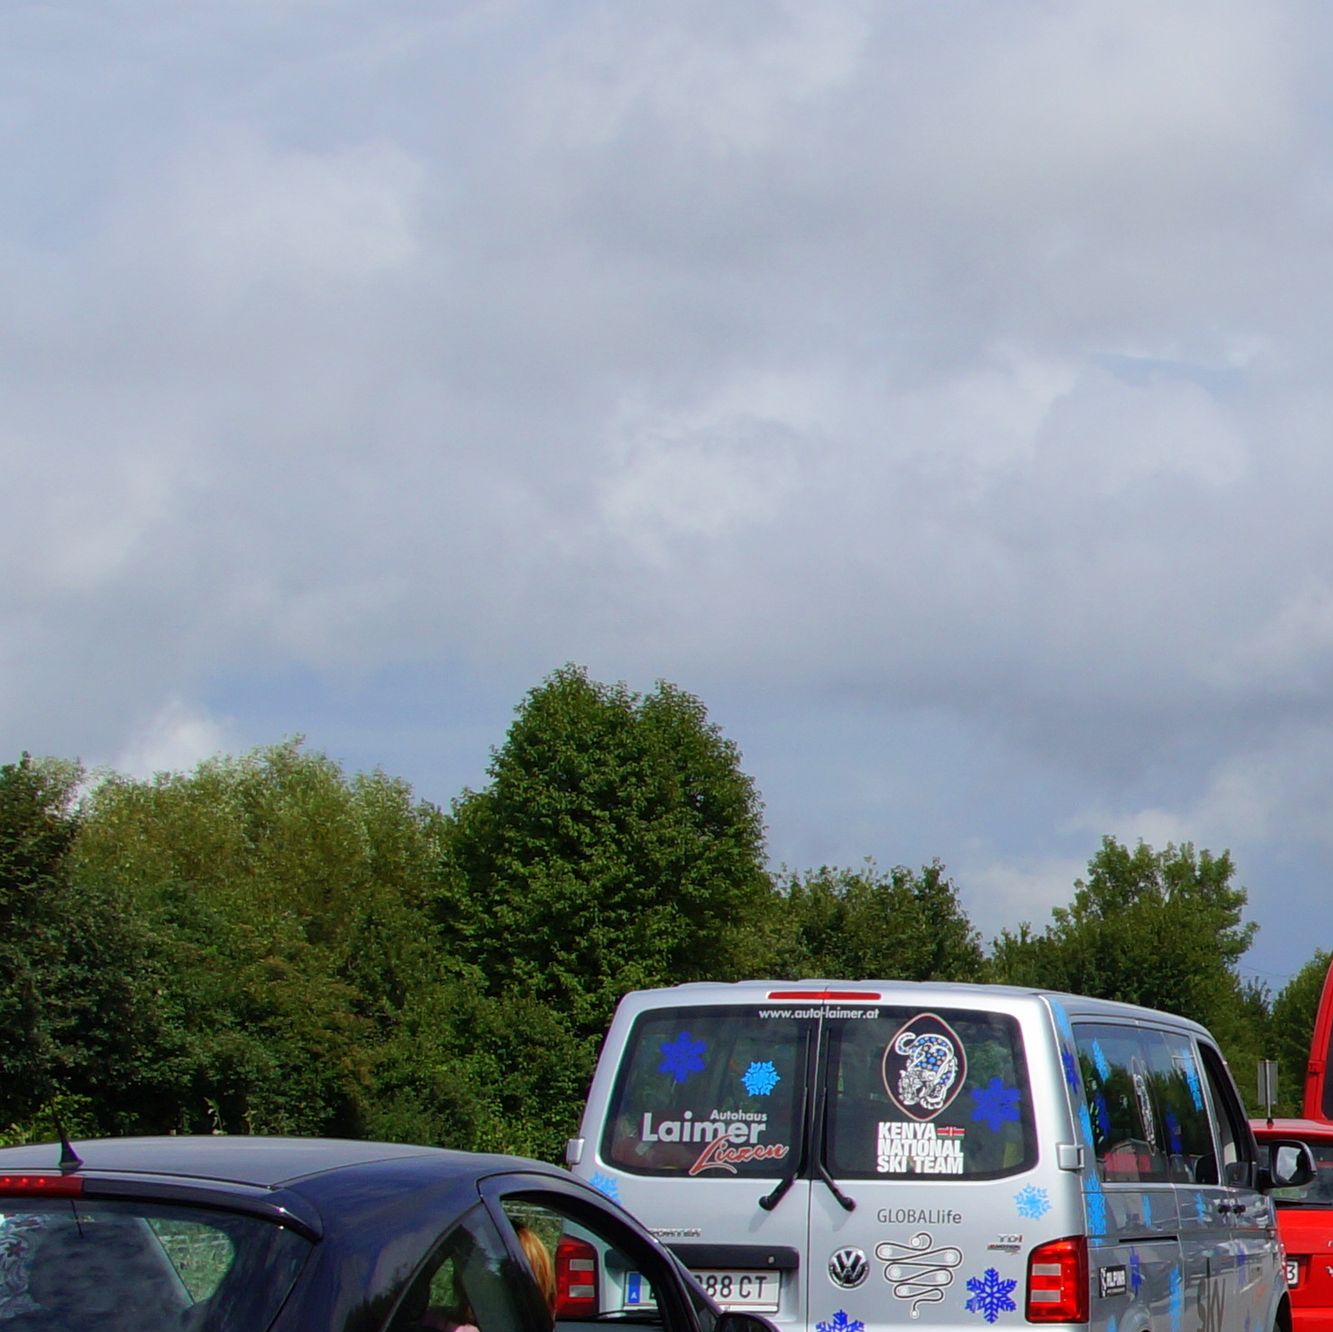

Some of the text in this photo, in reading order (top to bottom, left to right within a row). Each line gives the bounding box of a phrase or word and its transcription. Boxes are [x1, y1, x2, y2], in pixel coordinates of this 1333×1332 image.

[758, 1006, 880, 1019] www.auto-laimer.at
[710, 1109, 767, 1121] Autohaus
[642, 1110, 766, 1143] Laimer
[878, 1121, 936, 1139] KENYA
[877, 1139, 964, 1157] NATIONAL
[876, 1156, 964, 1174] SKI TEAM
[876, 1208, 963, 1224] GLOBALlife
[739, 1275, 768, 1299] CT
